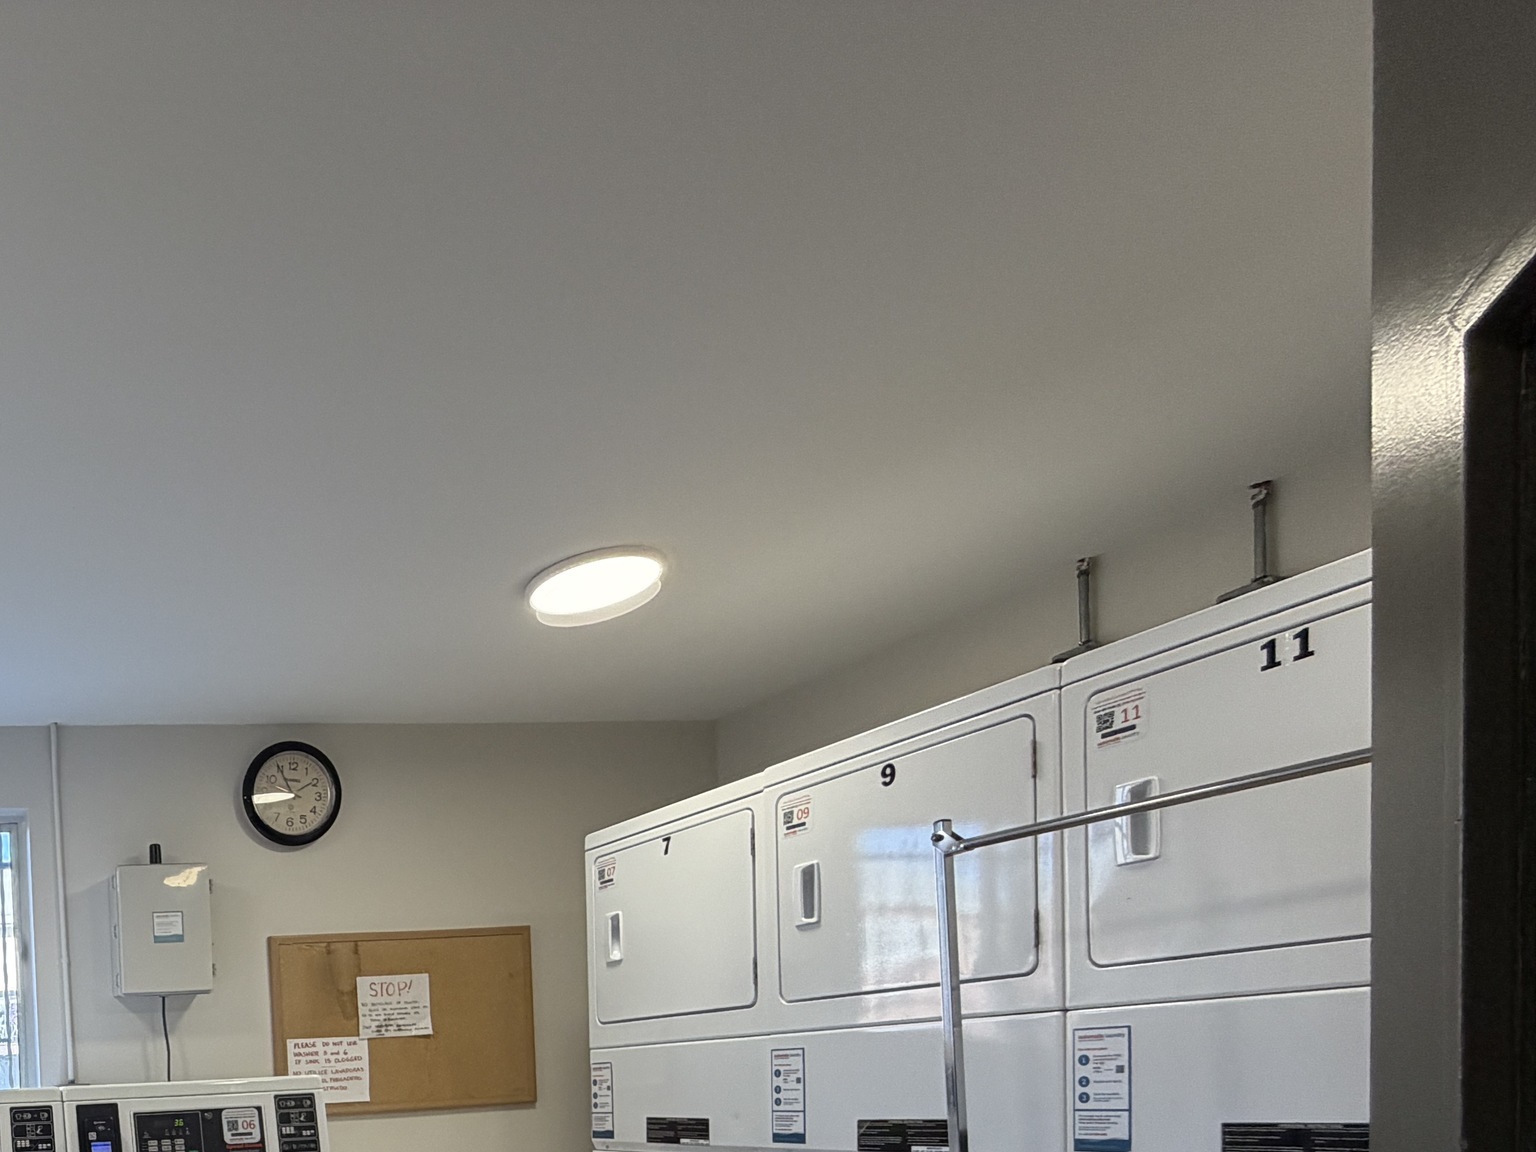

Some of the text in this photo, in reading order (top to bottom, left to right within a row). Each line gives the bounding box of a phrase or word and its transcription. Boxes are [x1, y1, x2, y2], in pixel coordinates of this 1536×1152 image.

[1260, 626, 1314, 672] 11
[1121, 704, 1141, 724] 11
[288, 761, 299, 771] 12
[266, 774, 277, 784] 10
[881, 763, 896, 787] 9
[311, 778, 319, 787] 2
[314, 791, 322, 801] 3
[309, 805, 317, 815] 4
[796, 806, 809, 821] 09
[273, 812, 281, 822] 7
[286, 817, 294, 827] 6
[299, 814, 307, 824] 5
[662, 836, 671, 855] 7
[607, 866, 616, 877] 07
[369, 979, 413, 997] STOP!
[293, 1041, 317, 1049] PLEASE
[241, 1119, 256, 1130] 06
